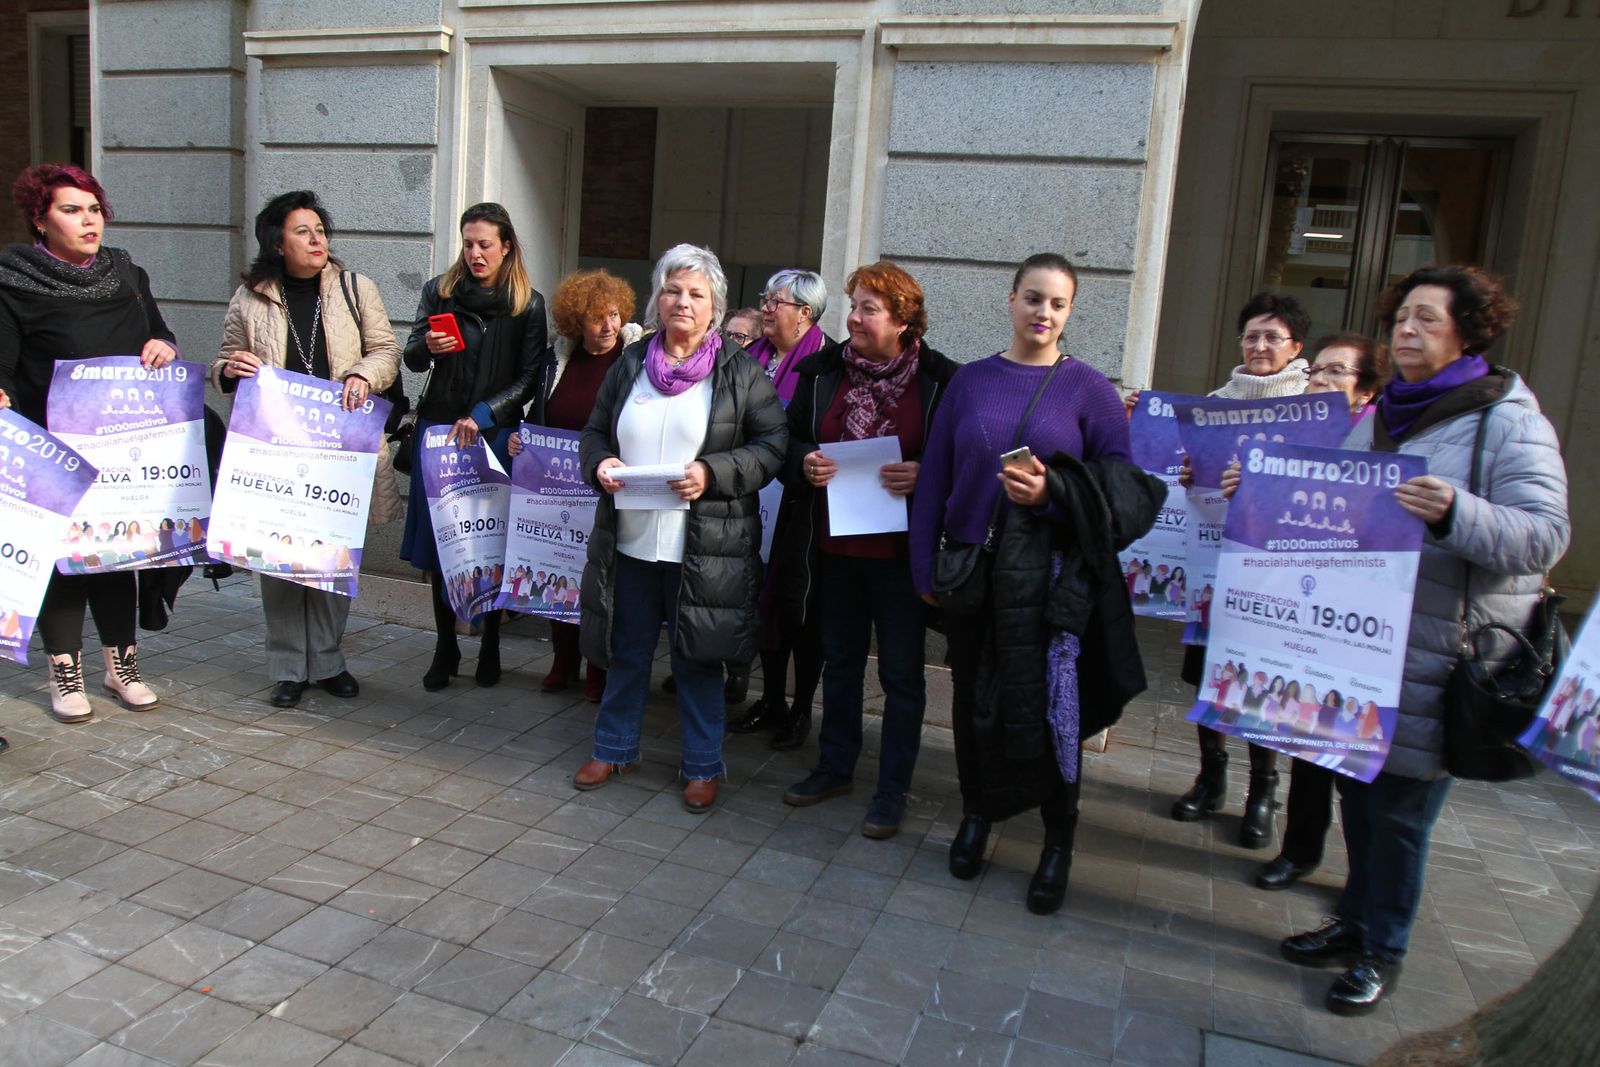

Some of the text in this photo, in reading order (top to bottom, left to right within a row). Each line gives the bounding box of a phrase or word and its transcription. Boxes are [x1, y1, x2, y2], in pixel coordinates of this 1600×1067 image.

[70, 364, 187, 382] 8marzo2019
[1192, 400, 1328, 427] 8marzo2019
[95, 416, 168, 436] #1000motivos
[77, 426, 186, 450] #hacialahuelgafeminista
[271, 436, 342, 449] #1000motivos
[141, 464, 201, 480] 19:00h
[1247, 447, 1400, 488] 8marzo2019
[230, 474, 360, 509] HUELVA 19:00h
[540, 487, 593, 496] #1000motivos
[459, 517, 505, 534] 19:00h
[517, 522, 589, 544] HUELVA 19:
[1266, 538, 1359, 551] #1000motivos
[1243, 557, 1386, 569] #hacialahuelgafeminista
[1224, 595, 1394, 642] HUELVA 19:00h
[1241, 616, 1266, 626] ANTIGUO
[1266, 620, 1291, 632] ESTADIO
[1291, 626, 1326, 640] COLOMBINO
[1353, 640, 1366, 649] LAS
[1366, 643, 1392, 656] MONJAS
[1284, 640, 1318, 656] HUELGA
[1243, 732, 1381, 753] MOVIMIENTO FEMINISTA DE HUELVA
